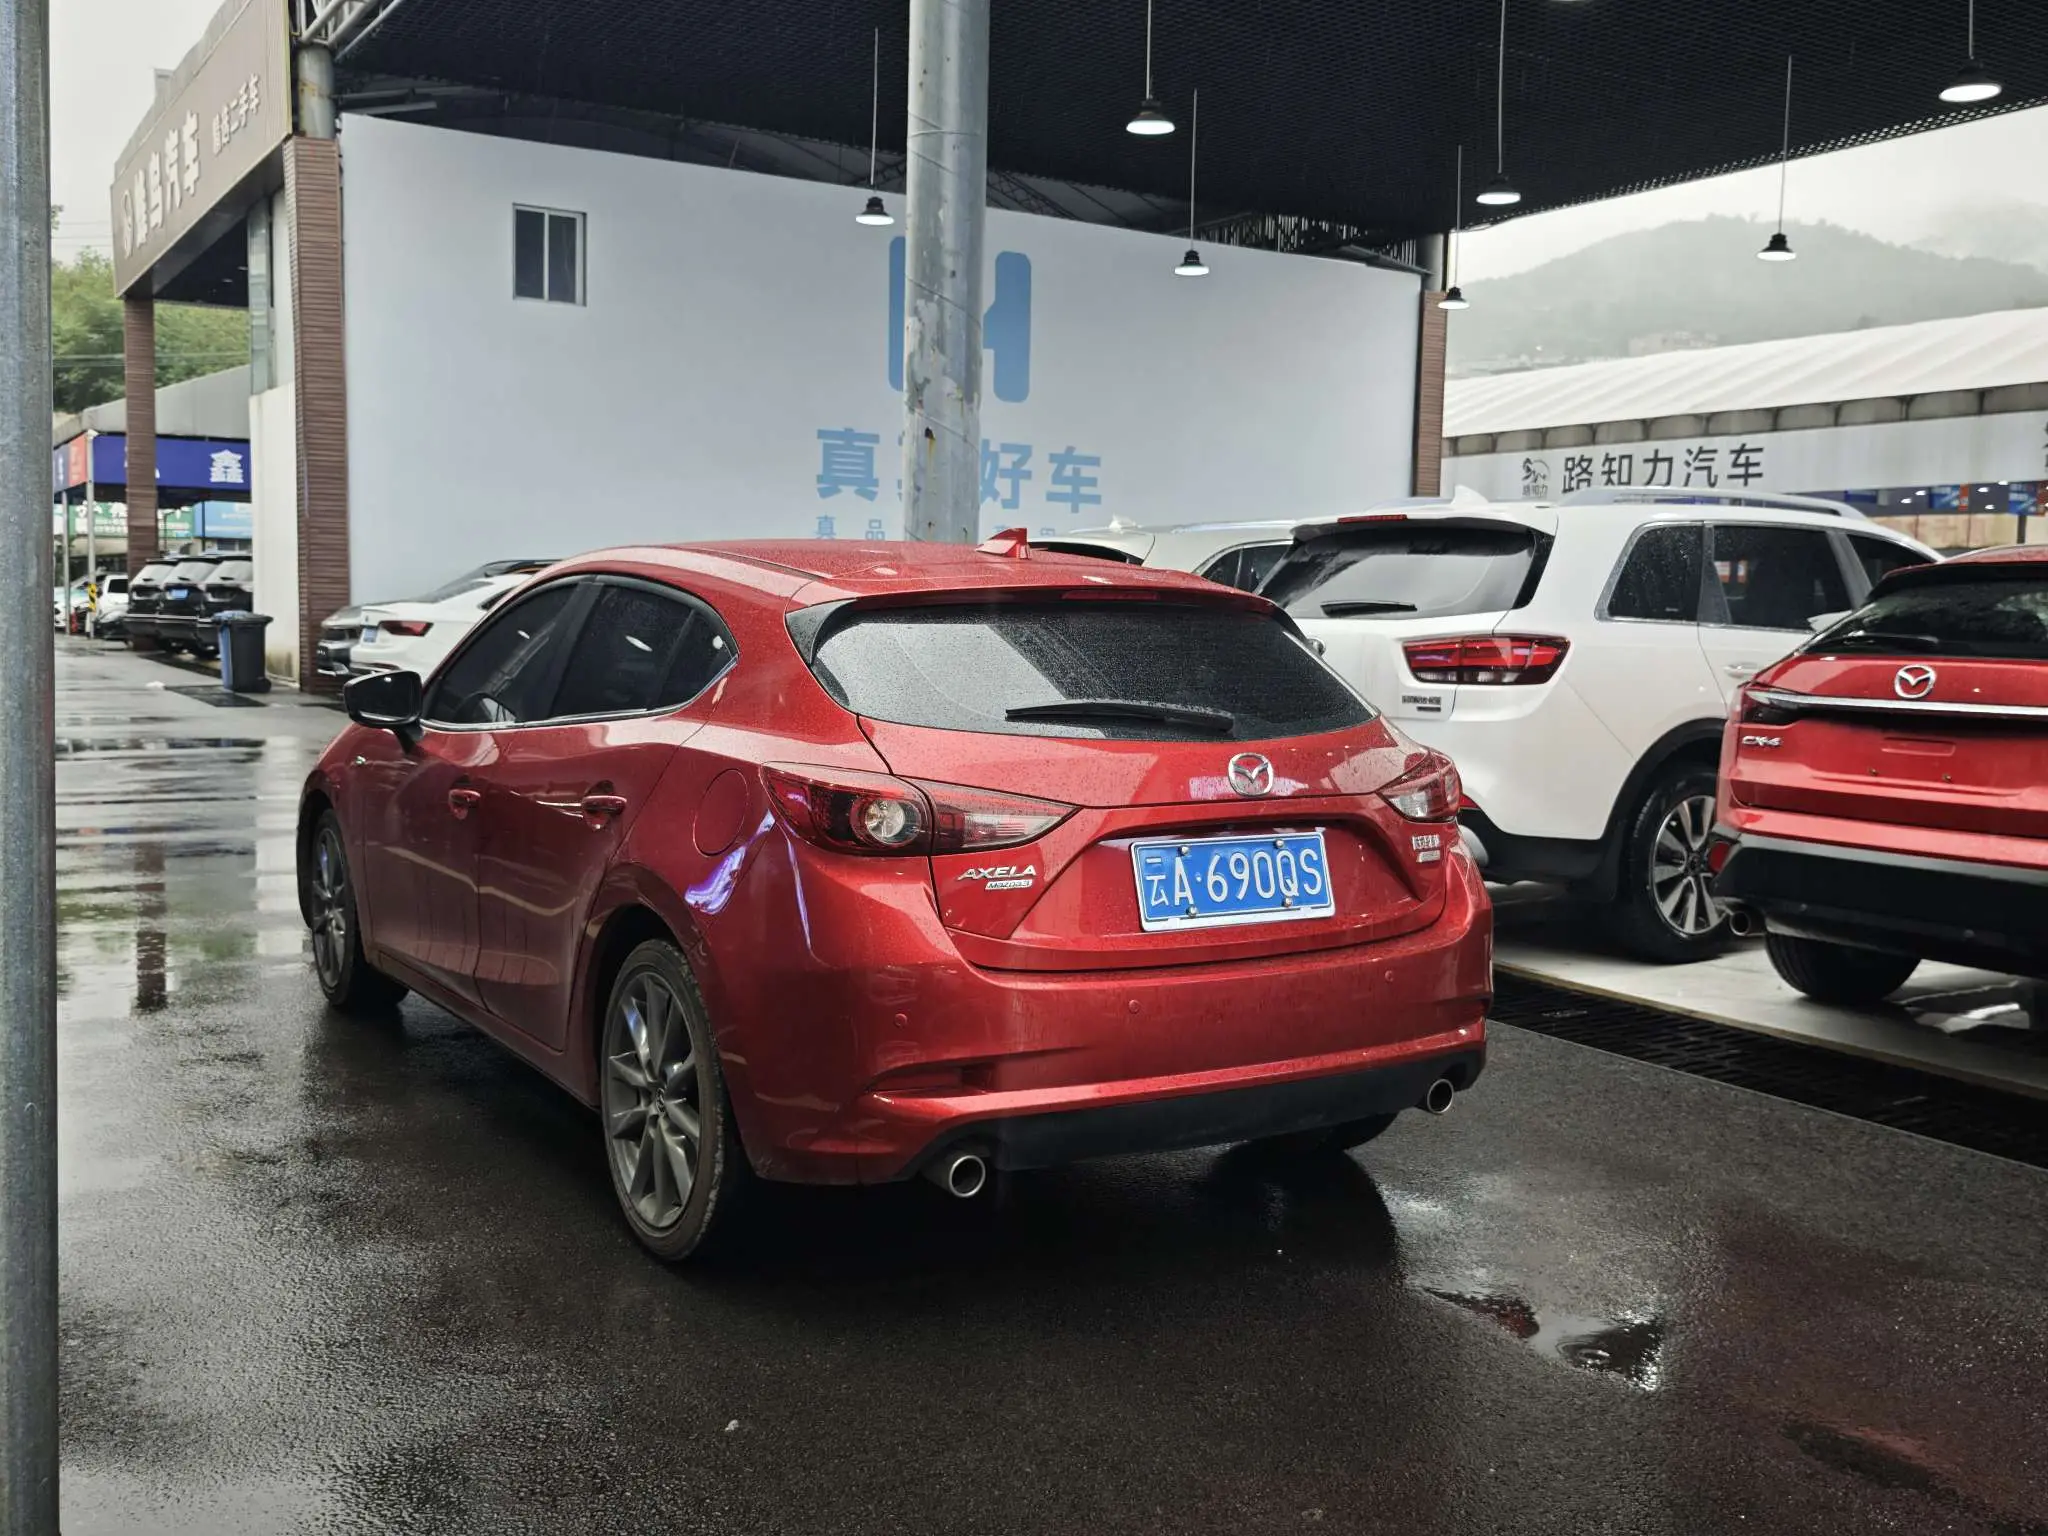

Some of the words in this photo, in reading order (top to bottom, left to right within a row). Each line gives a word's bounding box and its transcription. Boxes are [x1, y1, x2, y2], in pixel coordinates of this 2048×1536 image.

[209, 449, 244, 483] 鑫
[816, 427, 1102, 513] 真好车
[1561, 443, 1764, 494] 路知力汽车
[957, 865, 1037, 881] AXELA
